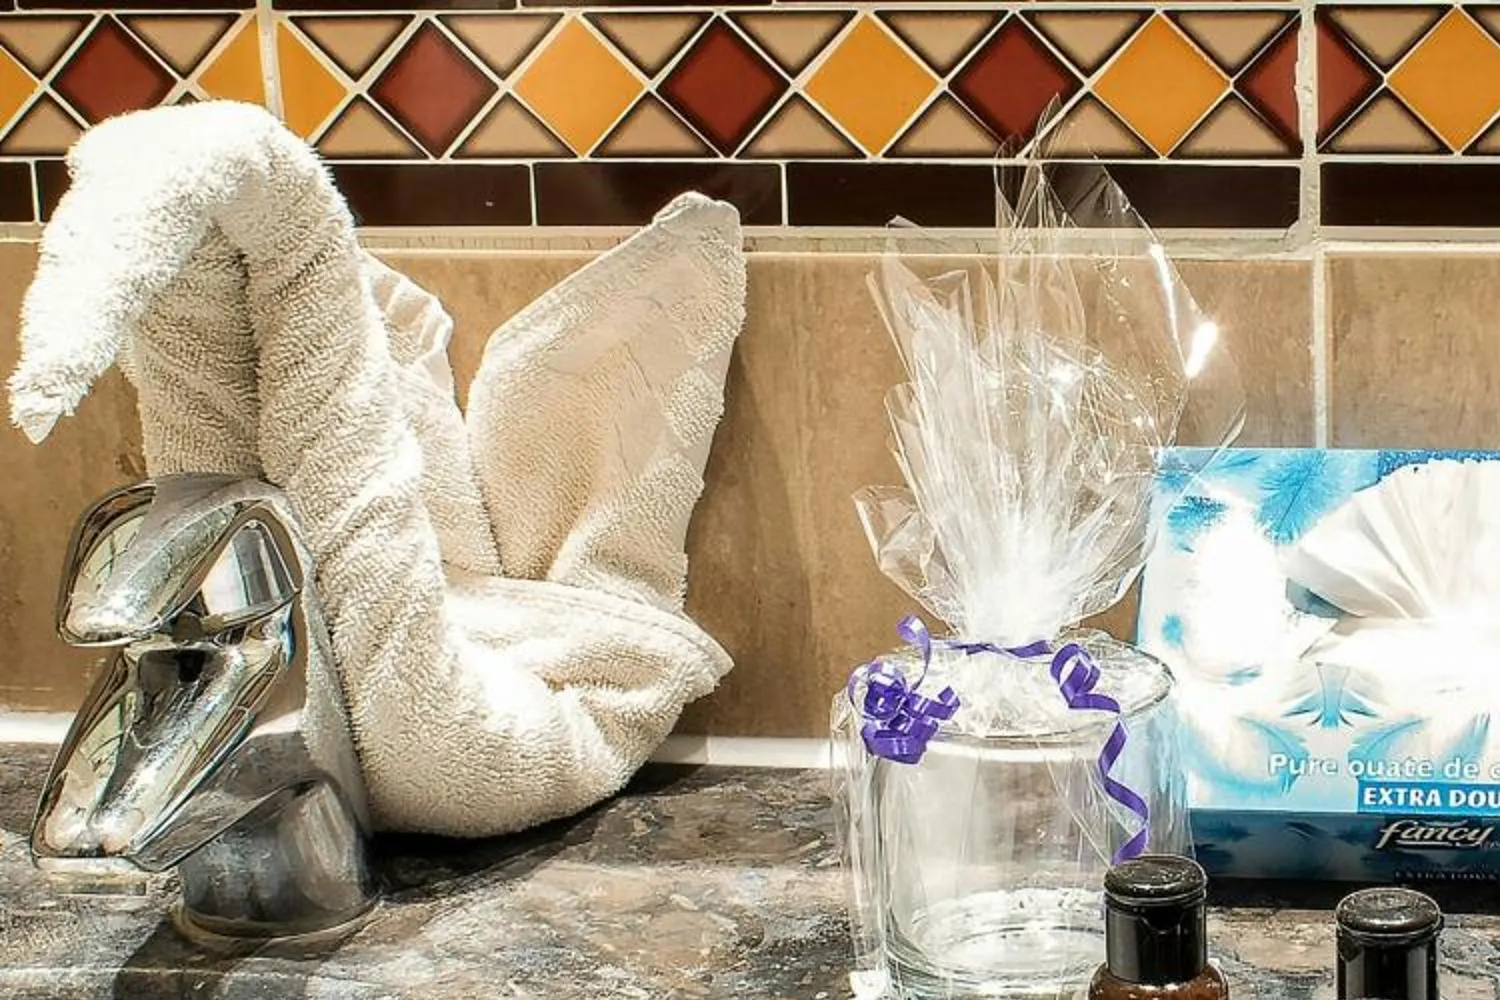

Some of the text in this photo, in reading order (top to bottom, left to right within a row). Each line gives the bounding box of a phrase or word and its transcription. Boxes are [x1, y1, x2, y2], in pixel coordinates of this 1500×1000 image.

[1269, 753, 1338, 776] Pure
[1349, 756, 1433, 778] ouate
[1443, 757, 1479, 779] de
[1364, 787, 1442, 806] EXTRA
[1376, 819, 1495, 849] fancy
